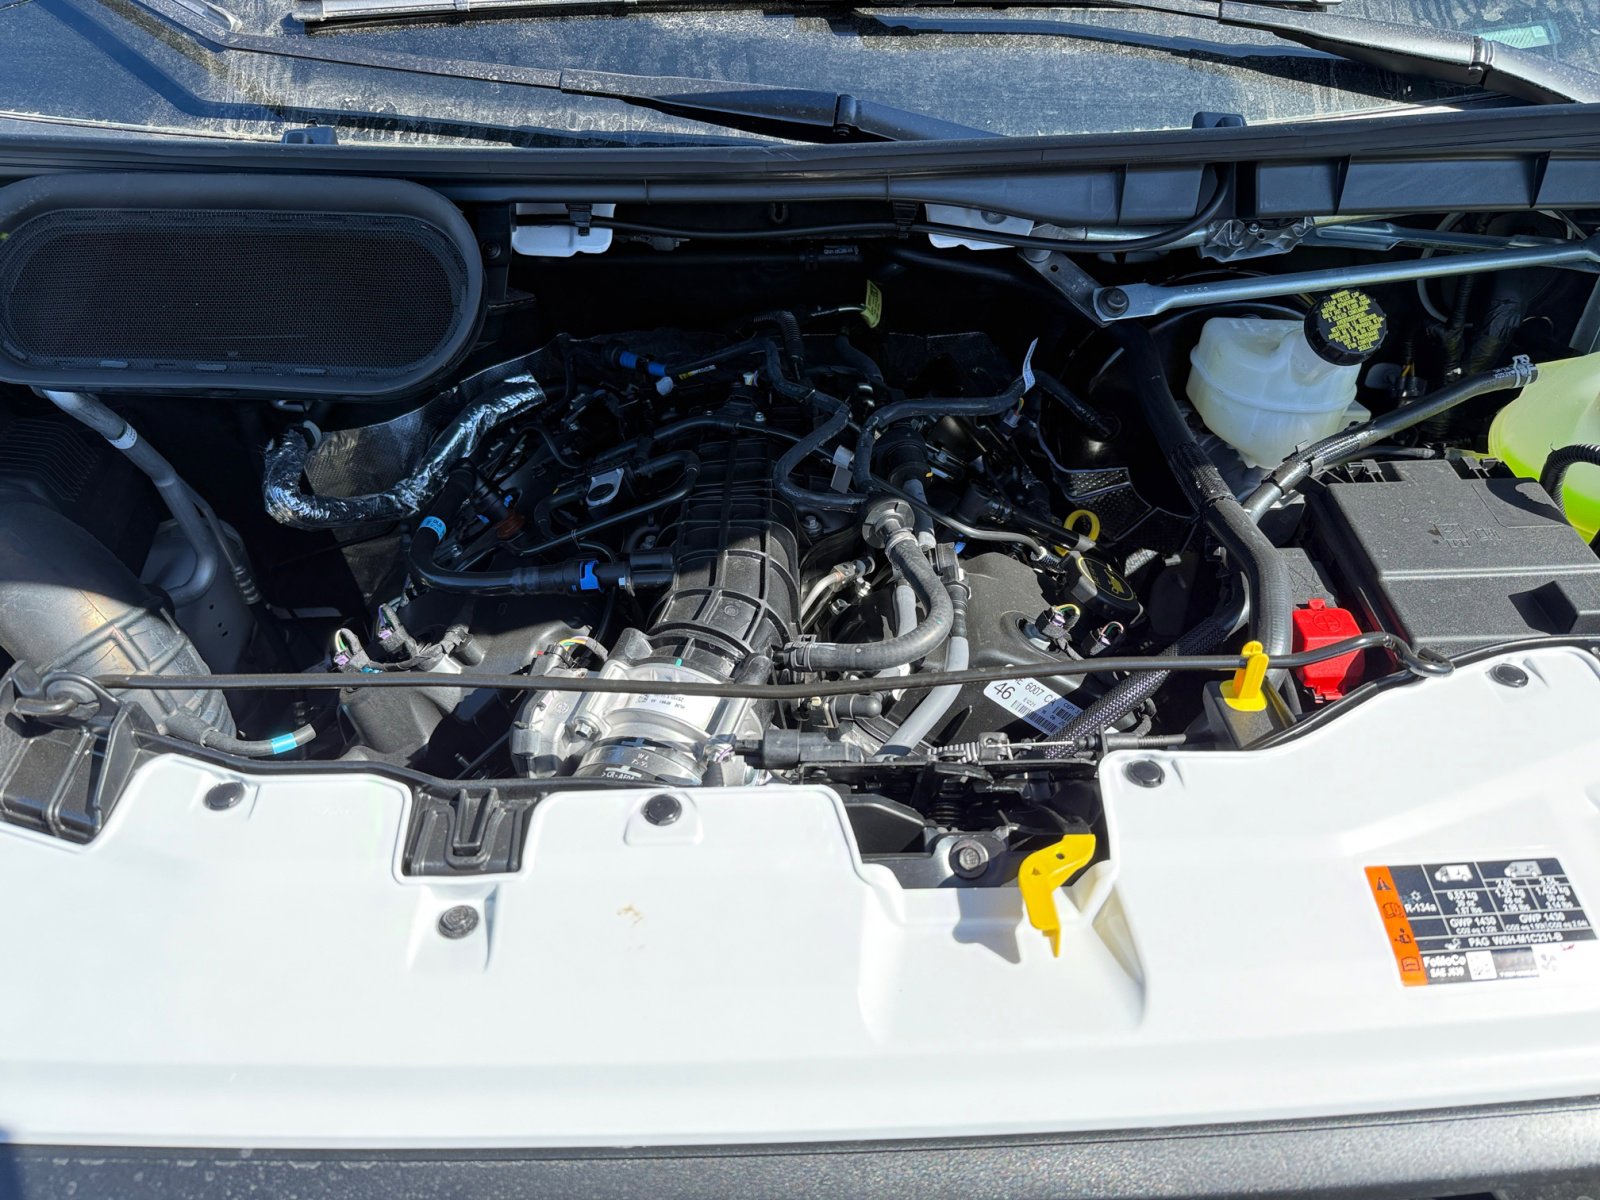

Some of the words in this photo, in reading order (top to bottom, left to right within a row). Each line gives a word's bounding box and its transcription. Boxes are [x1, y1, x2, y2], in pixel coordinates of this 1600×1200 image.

[1324, 300, 1337, 308] CLEAN
[1337, 294, 1351, 302] FILLER
[993, 682, 1016, 700] 46
[1025, 682, 1045, 697] 6007
[1466, 890, 1479, 900] kg
[1514, 888, 1526, 898] kg
[1559, 885, 1571, 896] kg
[1405, 903, 1437, 914] R-134a
[1449, 917, 1473, 929] GWP
[1474, 915, 1497, 926] 1430
[1519, 912, 1542, 924] GWP
[1543, 911, 1566, 922] 1430
[1468, 936, 1490, 948] PAG
[1423, 953, 1466, 968] FoMoCo
[1429, 967, 1446, 978] SAE
